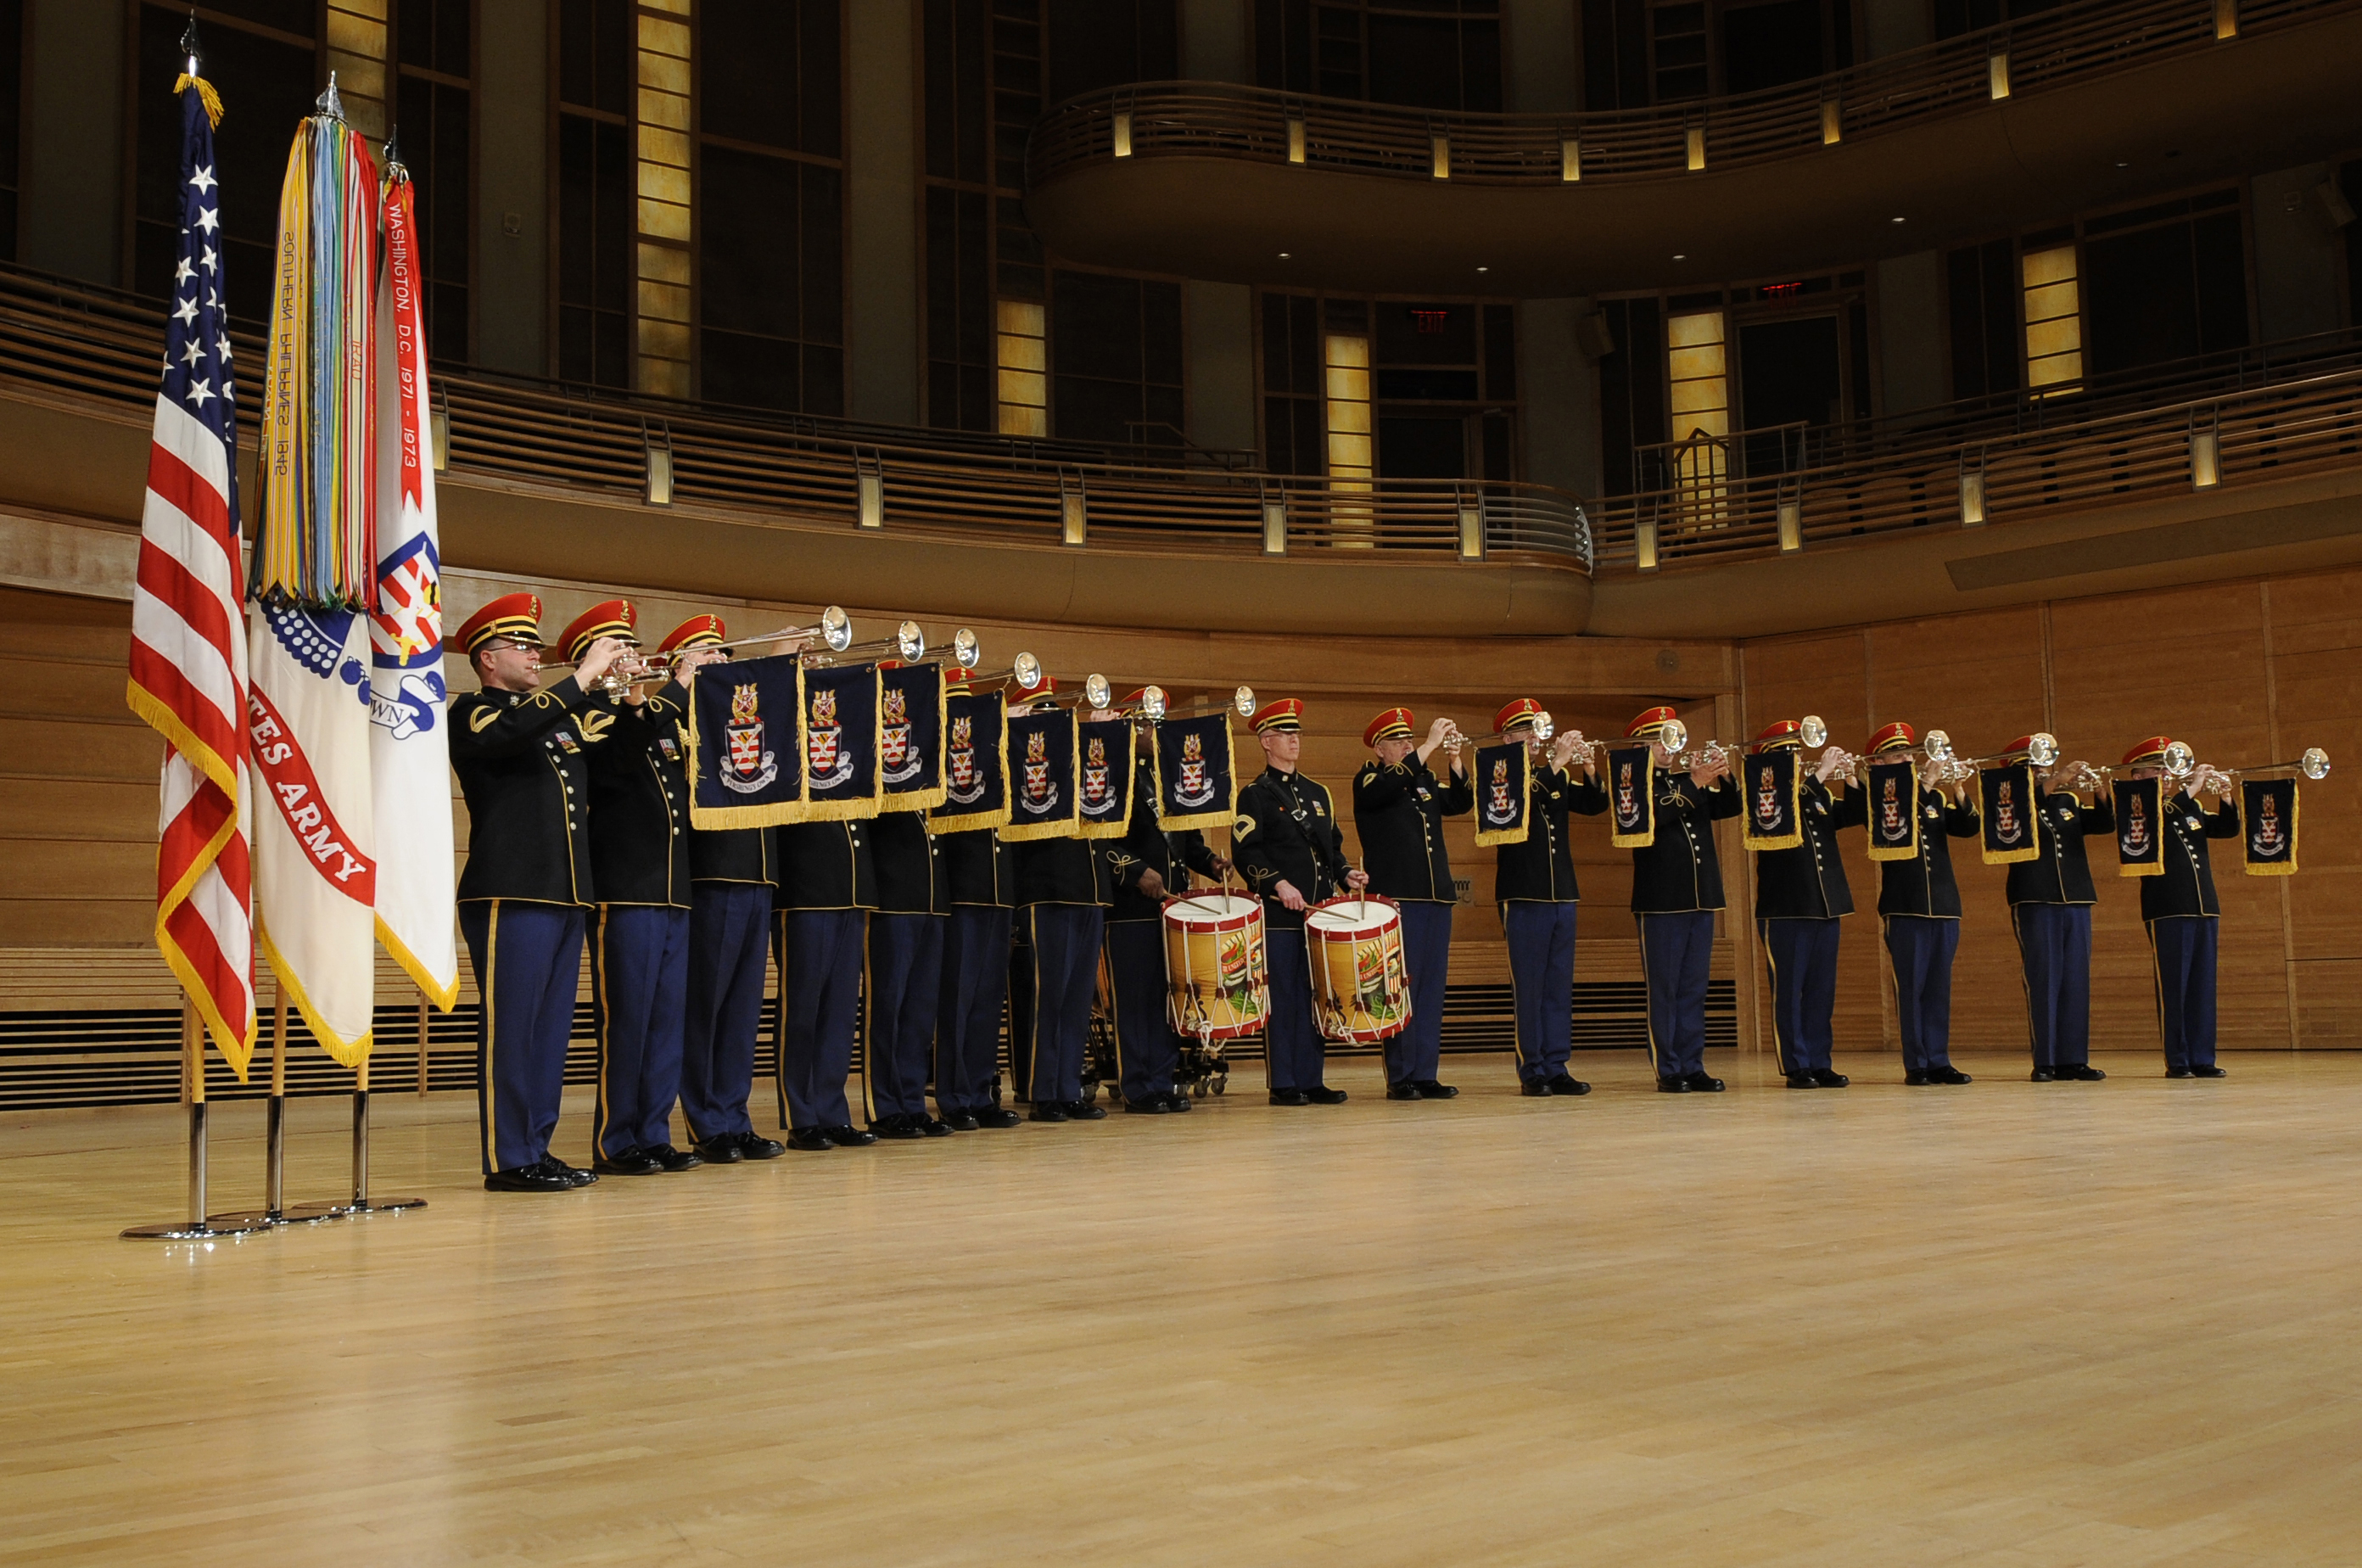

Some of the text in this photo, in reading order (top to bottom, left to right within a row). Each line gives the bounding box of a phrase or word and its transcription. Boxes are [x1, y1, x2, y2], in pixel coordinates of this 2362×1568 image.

[398, 324, 411, 355] D.C.
[1419, 315, 1445, 333] EXIT
[400, 367, 414, 400] 1971
[403, 428, 417, 468] 1973
[369, 697, 404, 723] WN
[276, 781, 367, 882] ARMY
